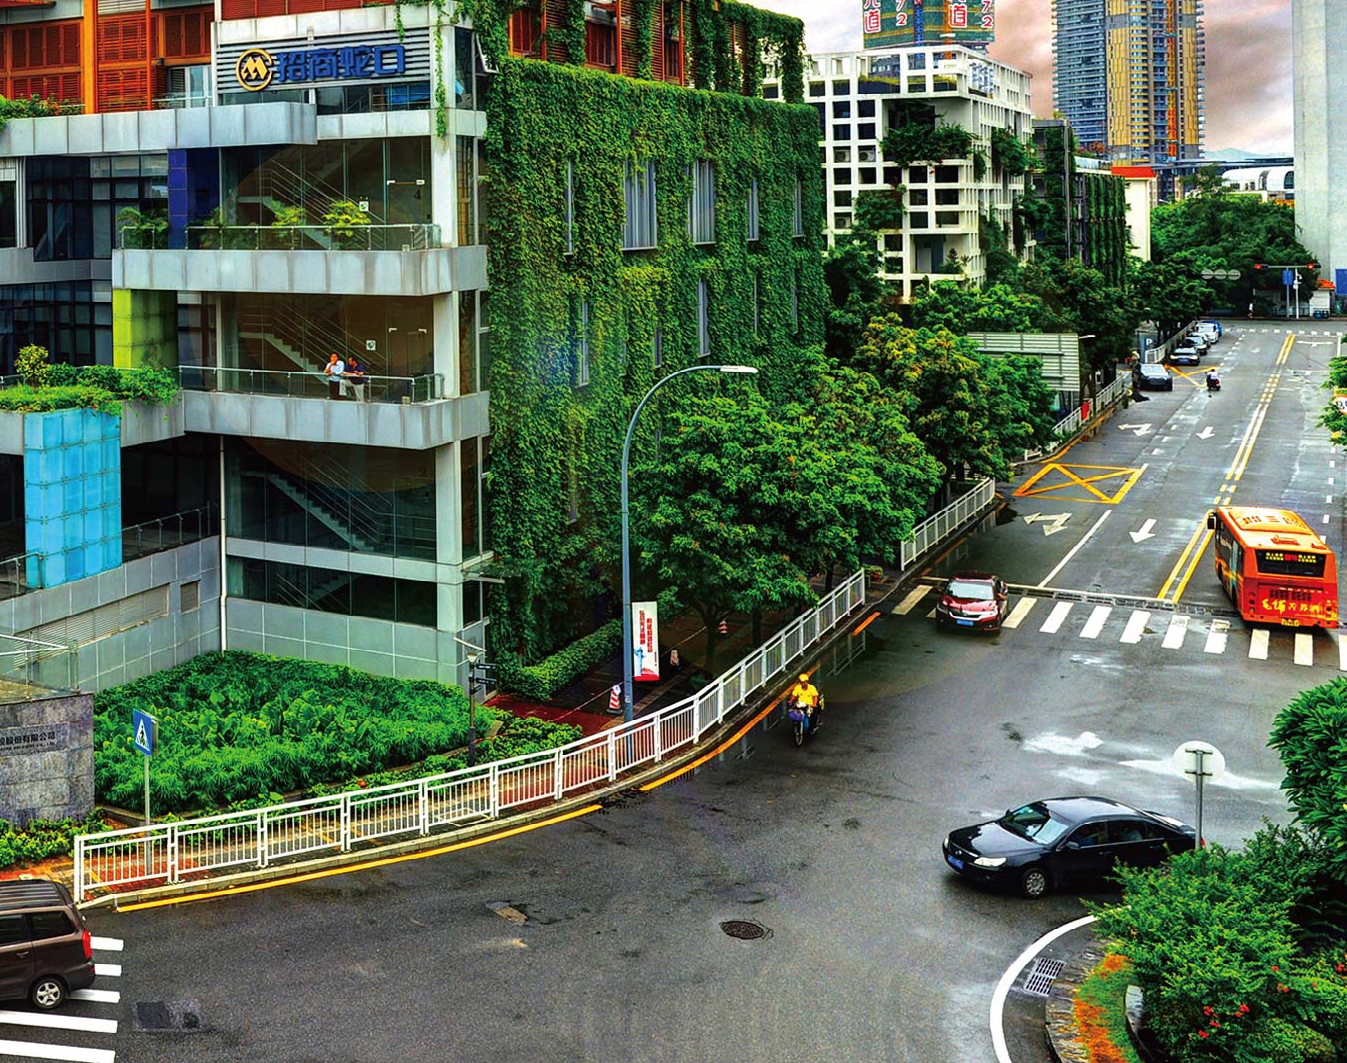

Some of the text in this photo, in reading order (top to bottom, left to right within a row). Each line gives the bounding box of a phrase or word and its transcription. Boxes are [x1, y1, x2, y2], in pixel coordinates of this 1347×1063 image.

[277, 45, 406, 82] 招商蛇口
[1146, 338, 1153, 346] P
